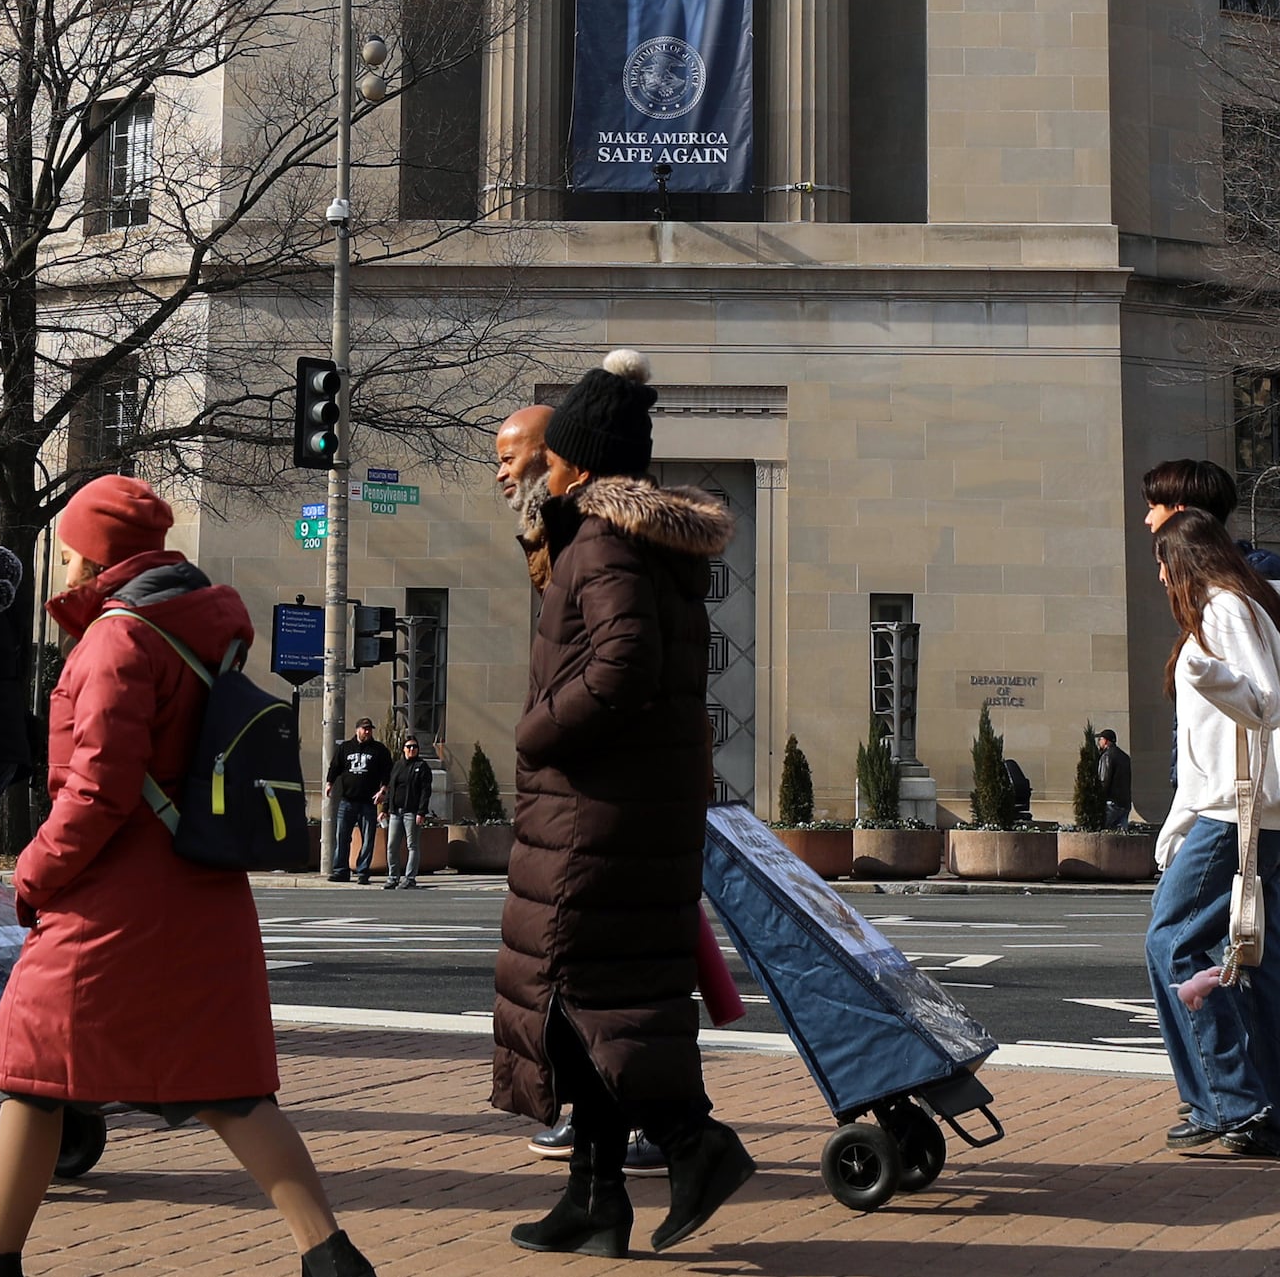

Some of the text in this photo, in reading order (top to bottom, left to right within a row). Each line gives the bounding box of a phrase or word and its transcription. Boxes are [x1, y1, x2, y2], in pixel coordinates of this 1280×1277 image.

[631, 43, 668, 88] DEPARTMENT
[598, 131, 729, 145] MAKE AMERICA
[597, 147, 730, 164] SAFE AGAIN
[363, 484, 408, 502] Pennsylvania
[373, 503, 394, 513] 900
[300, 522, 309, 537] 9
[304, 538, 321, 549] 200
[970, 676, 1038, 686] DEPARTMENT
[997, 687, 1012, 696] OF
[1245, 859, 1255, 891] POLO
